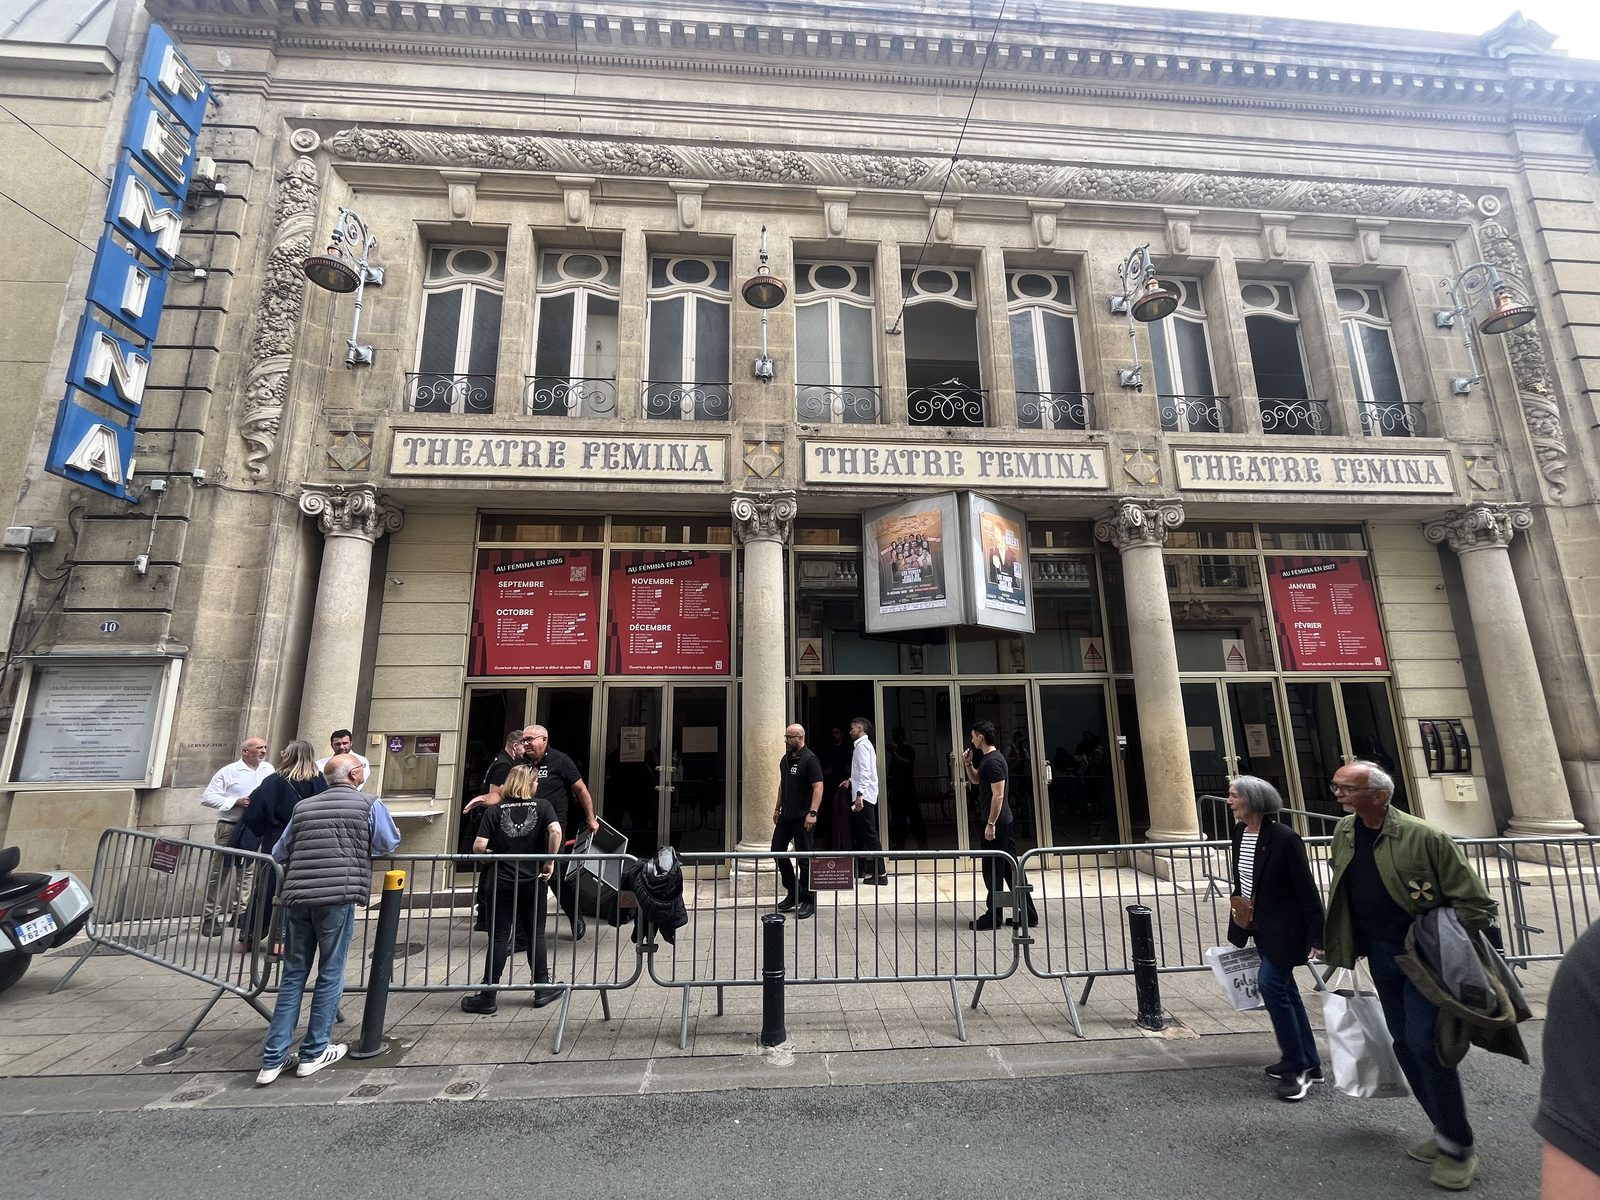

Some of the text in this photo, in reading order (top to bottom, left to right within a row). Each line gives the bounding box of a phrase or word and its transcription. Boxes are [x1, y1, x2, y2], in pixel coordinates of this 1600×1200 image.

[64, 44, 205, 486] FEMINA
[402, 437, 713, 472] THEATRE FEMINA
[815, 446, 1099, 480] THEATRE FEMINA
[1184, 454, 1445, 485] THEATRE FEMINA
[495, 565, 506, 573] AU
[507, 561, 535, 571] FÉMINA
[547, 558, 563, 566] 2026
[627, 566, 637, 574] AU
[638, 562, 665, 572] FÉMINA
[676, 559, 693, 567] 2026
[496, 608, 534, 616] OCTOBRE
[104, 622, 117, 632] 10
[629, 623, 672, 631] DÉCEMBRE
[1294, 621, 1322, 629] FÉVRIER
[22, 922, 54, 942] 762-YT
